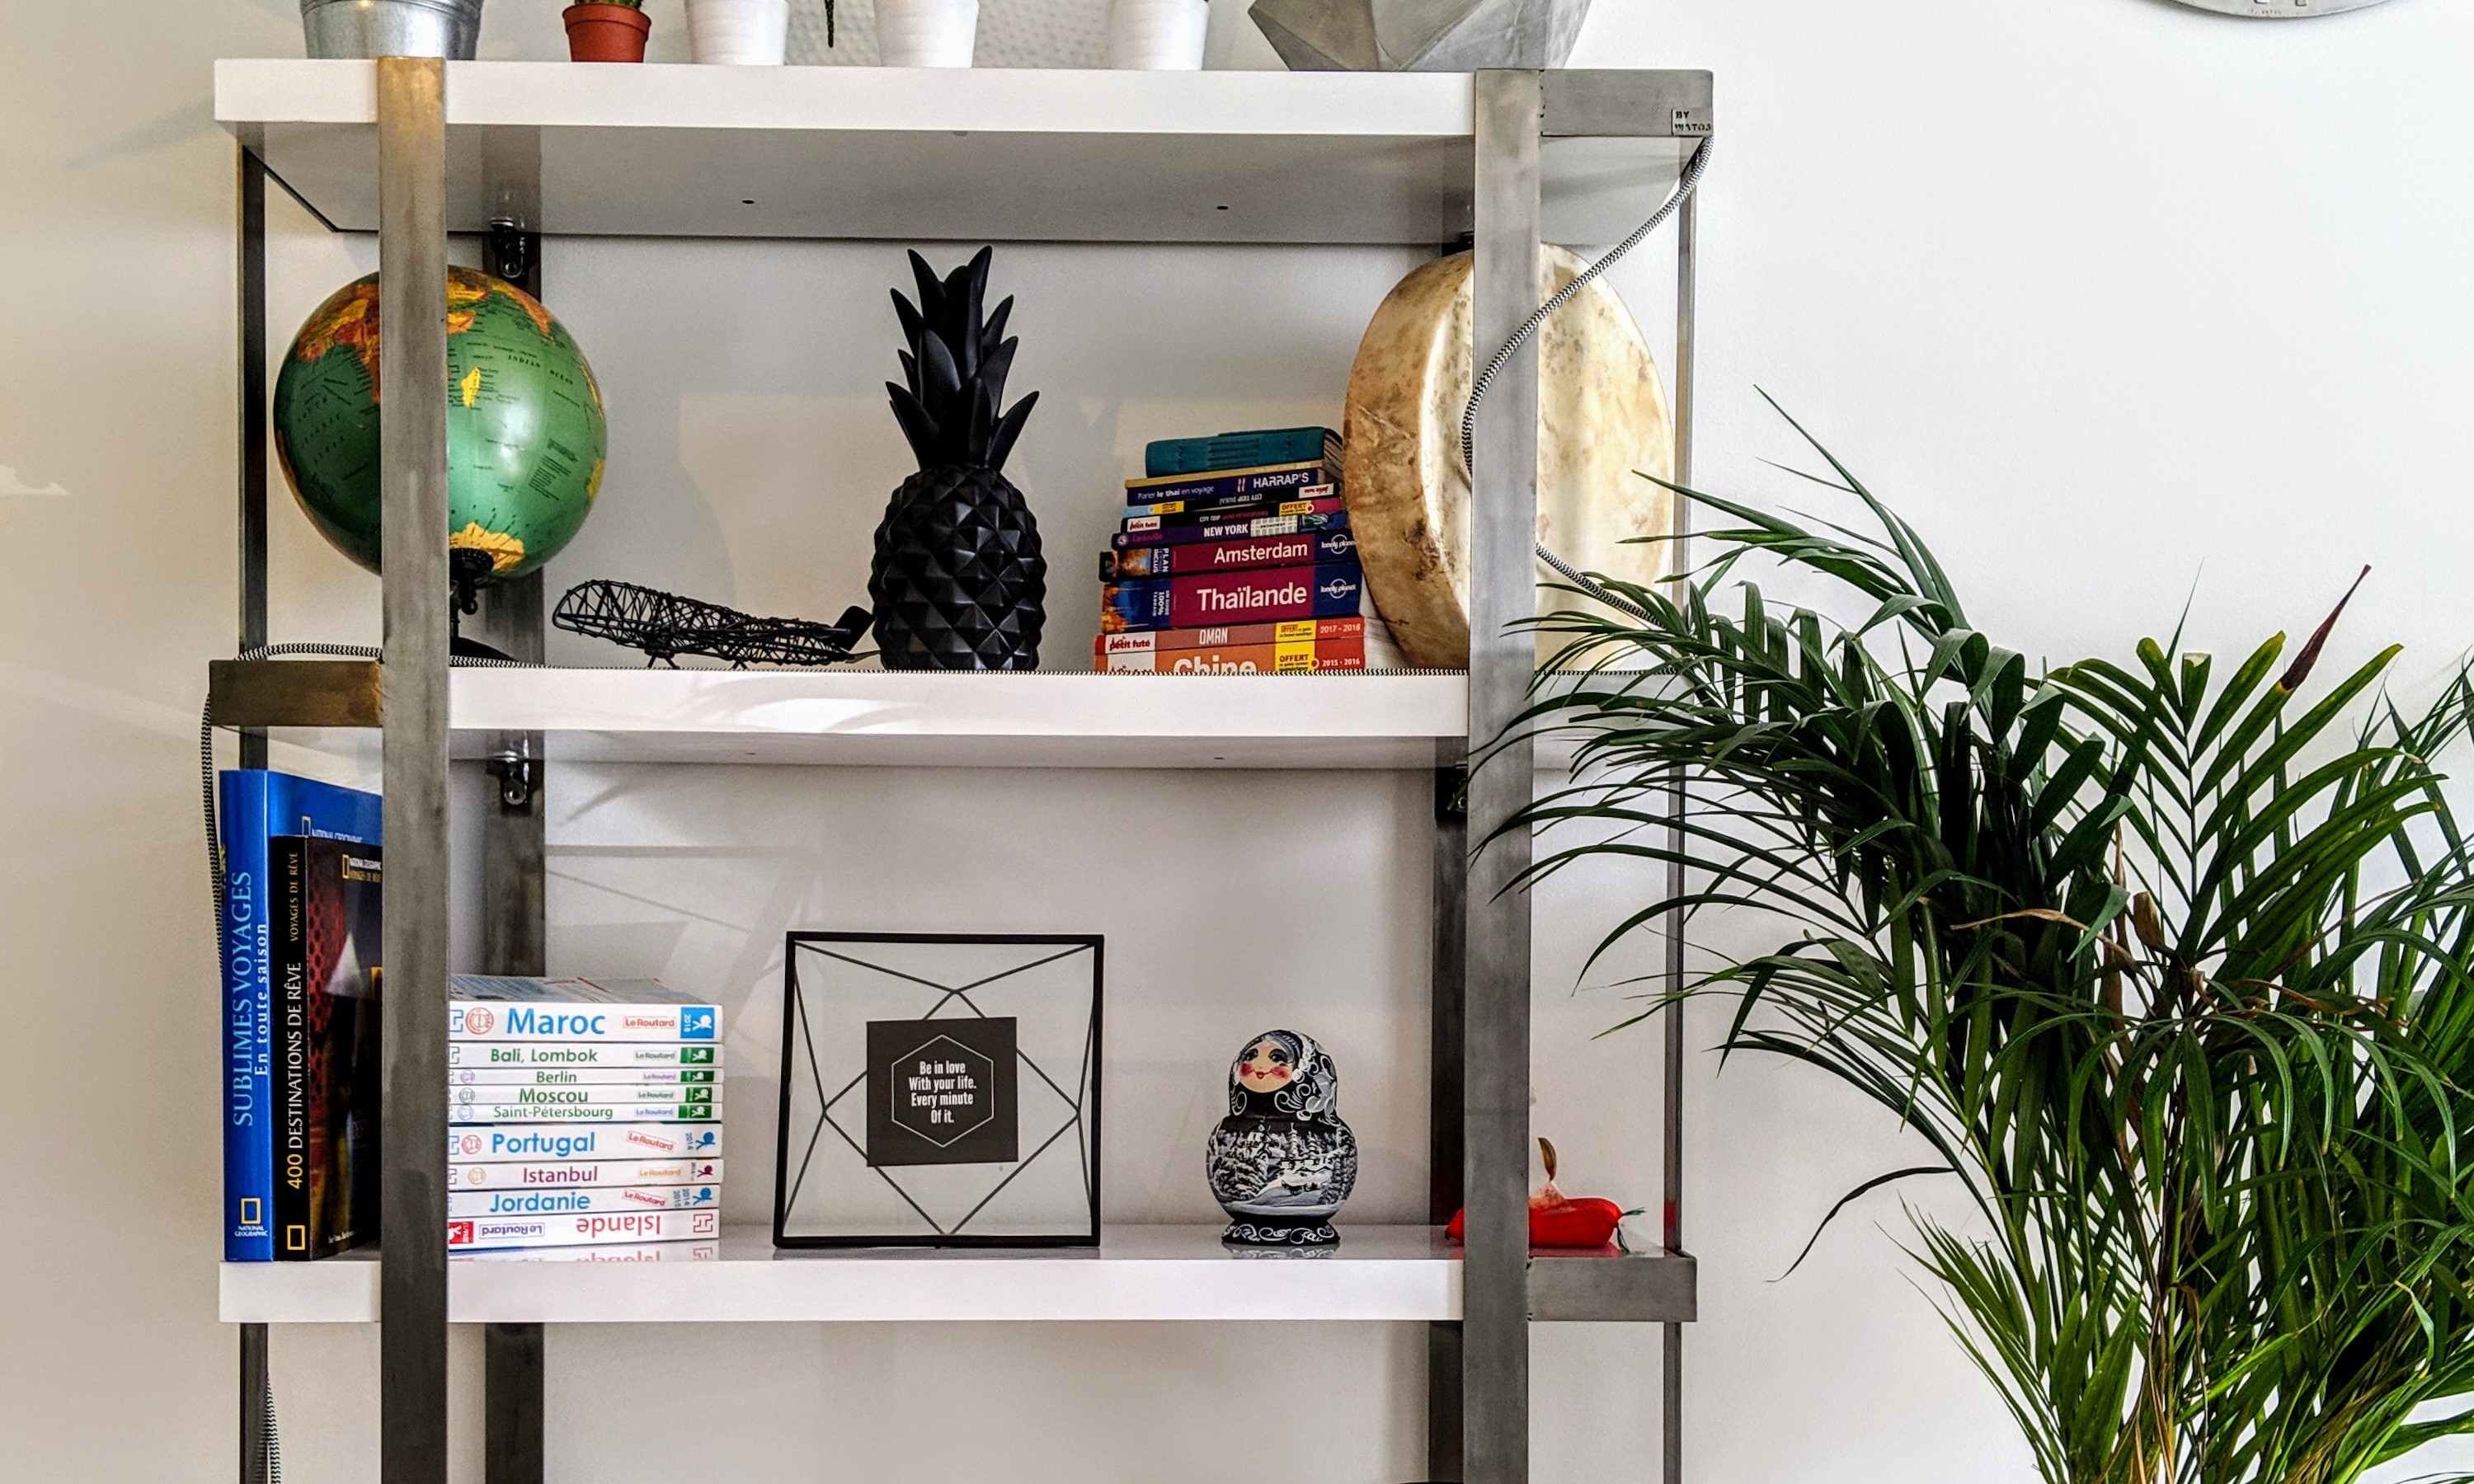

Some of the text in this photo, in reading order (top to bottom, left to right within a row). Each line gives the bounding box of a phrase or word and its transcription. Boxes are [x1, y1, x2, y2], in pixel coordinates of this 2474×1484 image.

[1676, 110, 1690, 119] BY
[1253, 472, 1310, 488] HARRAP'S
[1191, 486, 1215, 495] voyage
[1281, 502, 1307, 510] OFFERT
[1204, 524, 1249, 538] NEW YORK
[1213, 542, 1308, 564] Amsterdam
[1197, 581, 1309, 612] Thaïlande
[1199, 627, 1229, 645] OMAN
[1319, 625, 1337, 634] 2017
[1109, 636, 1131, 651] petit
[1279, 654, 1309, 662] OFFERT
[289, 881, 299, 894] DE
[289, 897, 299, 942] VOYAGES
[232, 871, 253, 1126] SUBLIMES VOYAGES
[254, 923, 268, 1076] En toute saison
[506, 1007, 607, 1036] Maroc
[626, 1018, 675, 1027] Le Routard
[683, 1013, 692, 1033] 2018
[490, 1048, 598, 1064] Bali, Lombok
[284, 962, 303, 1189] 400 DESTINATIONS DE RÊVE
[920, 1060, 966, 1075] Be in love
[536, 1071, 577, 1083] Berlin
[908, 1075, 977, 1093] With your life.
[519, 1087, 589, 1103] Moscou
[910, 1092, 974, 1108] Every minute
[493, 1105, 614, 1120] Saint-Pétersbourg
[930, 1109, 955, 1124] Of it.
[492, 1132, 595, 1157] Portugal
[628, 1133, 674, 1151] Le Routard
[685, 1132, 694, 1151] 2014
[523, 1166, 598, 1183] Istanbul
[489, 1192, 590, 1213] Jordanie
[634, 1193, 666, 1206] Routard
[682, 1187, 691, 1206] 2014
[482, 1224, 528, 1236] Routard
[529, 1225, 542, 1235] Le
[576, 1215, 661, 1238] Islande
